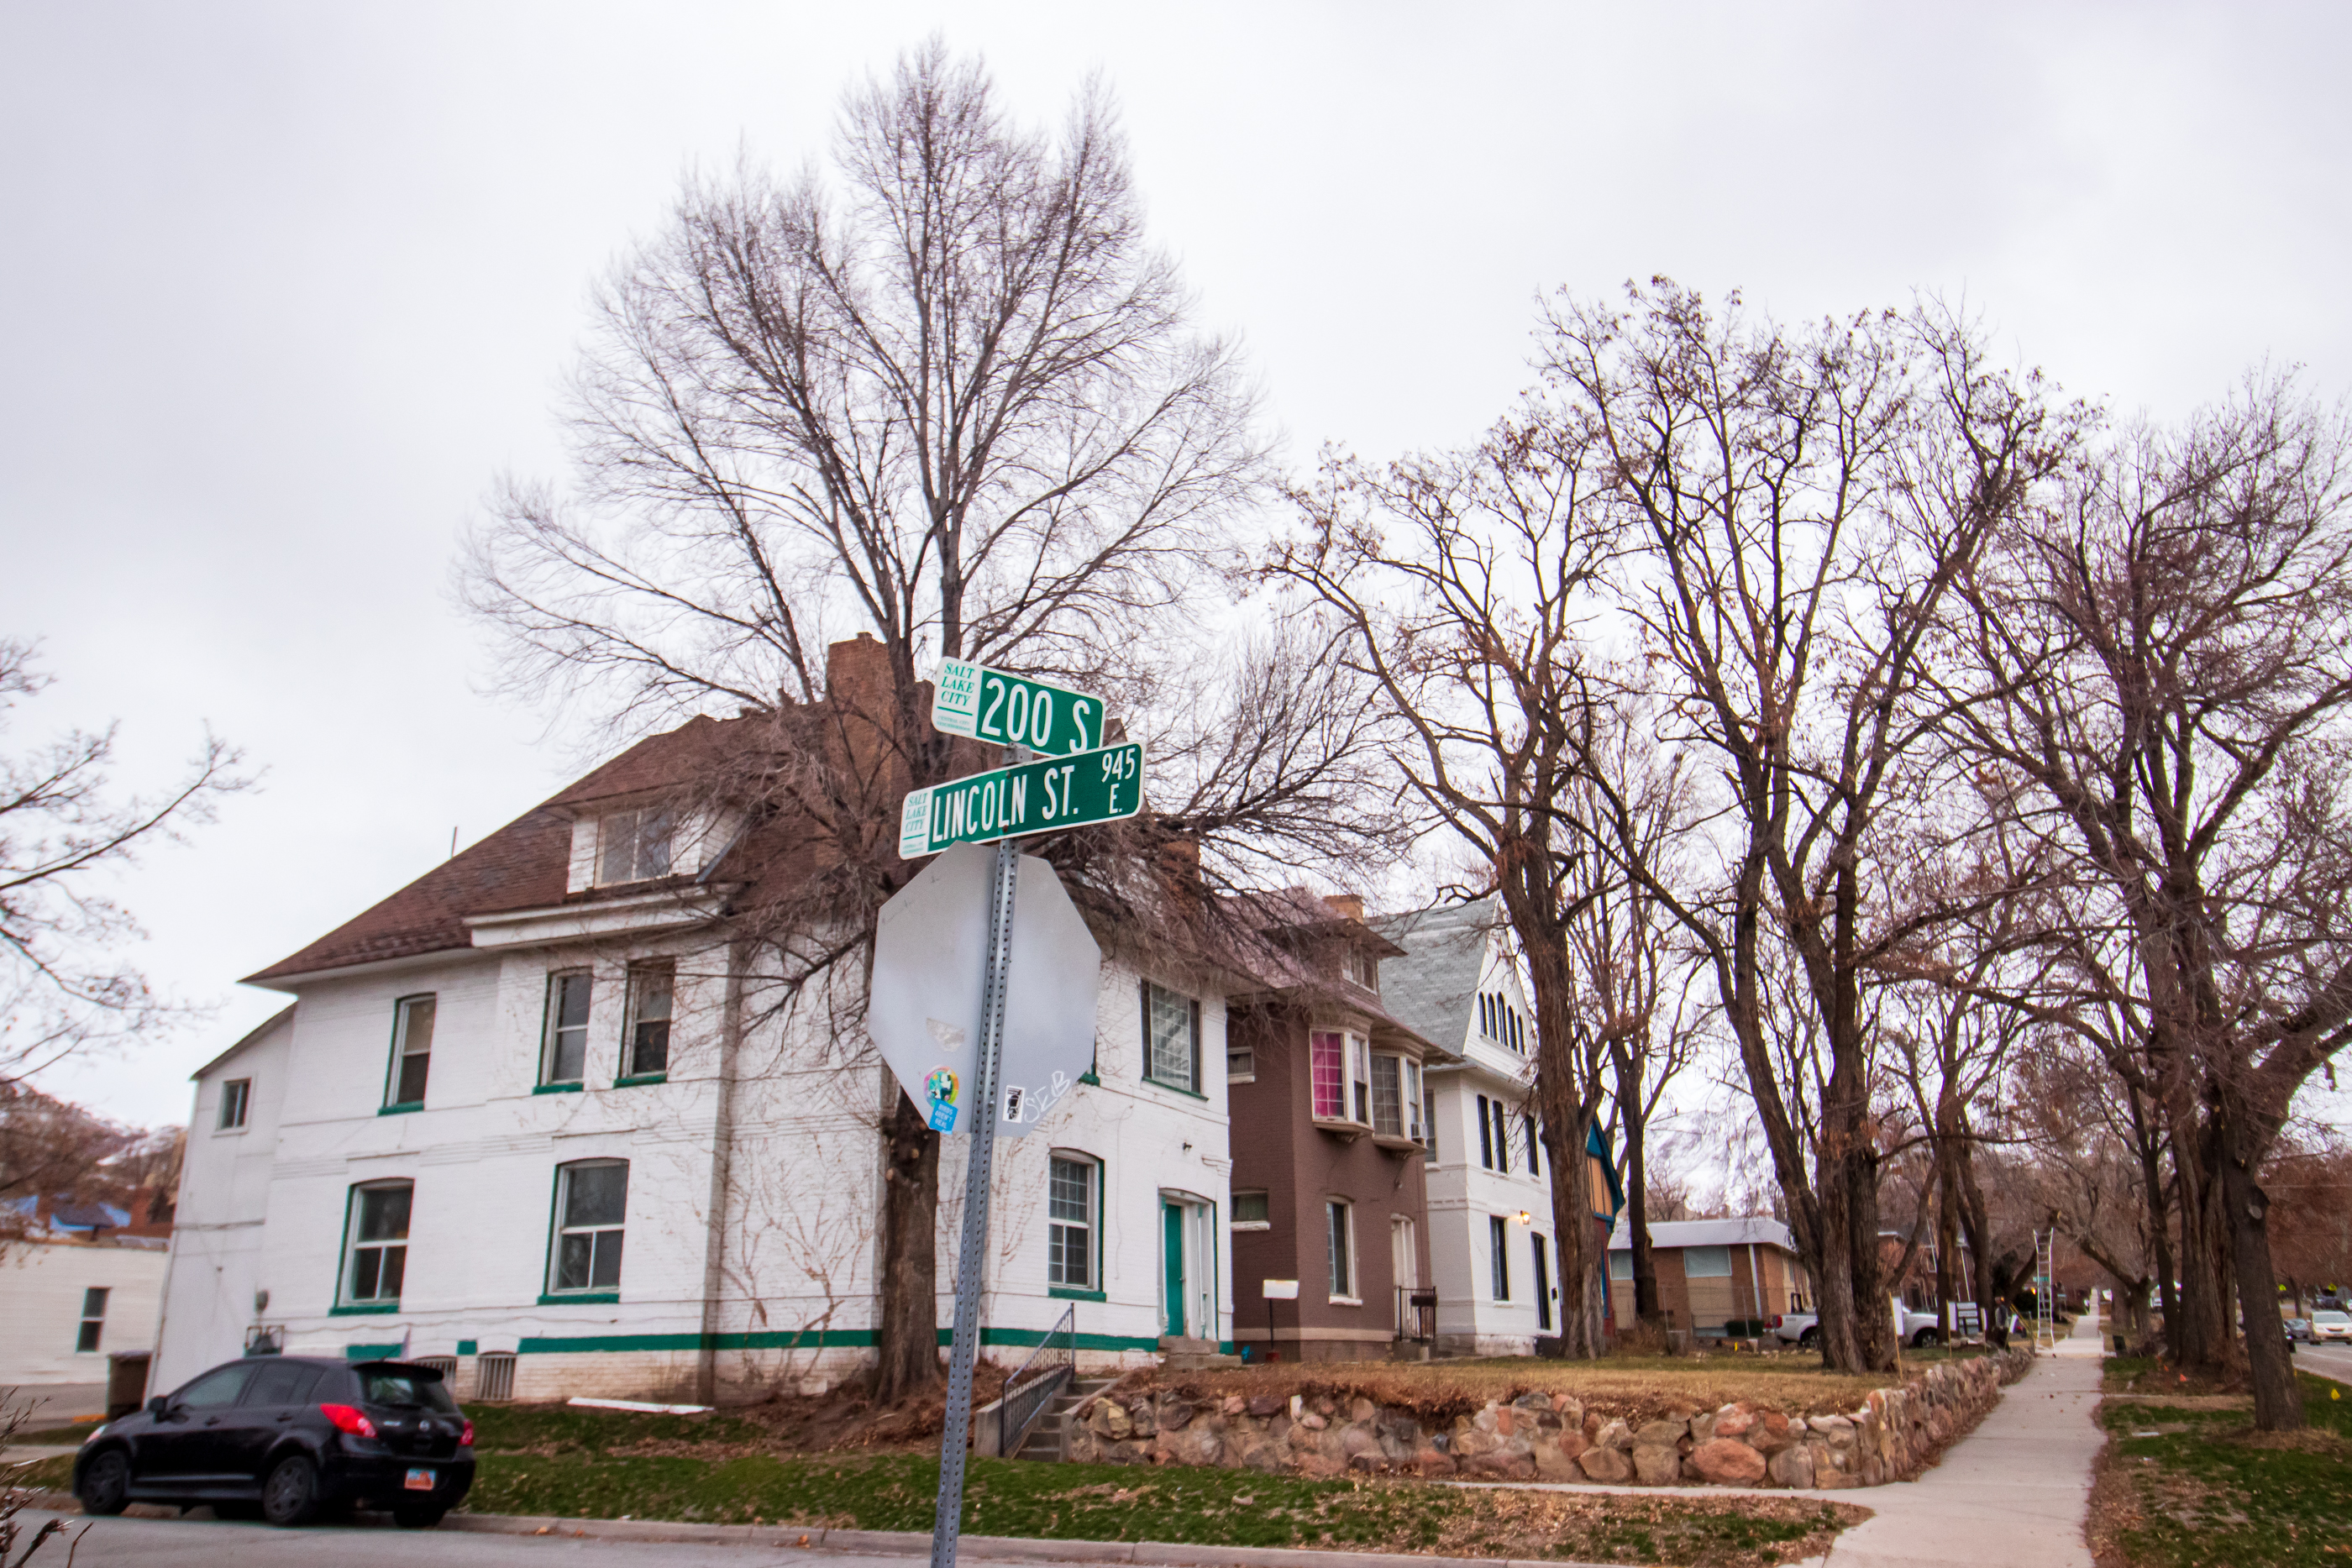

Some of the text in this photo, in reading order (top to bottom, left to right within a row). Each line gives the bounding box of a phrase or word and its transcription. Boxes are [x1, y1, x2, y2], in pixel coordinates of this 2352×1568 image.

[944, 662, 975, 679] SALT
[941, 676, 974, 694] LAKE
[941, 690, 970, 706] CITY
[981, 678, 1090, 753] 200 S
[1101, 748, 1136, 783] 945
[908, 793, 927, 806] SALT
[932, 765, 1079, 842] LINCOLN ST.
[1109, 784, 1122, 814] E.
[906, 805, 927, 820] LAKE
[906, 819, 924, 832] CITY
